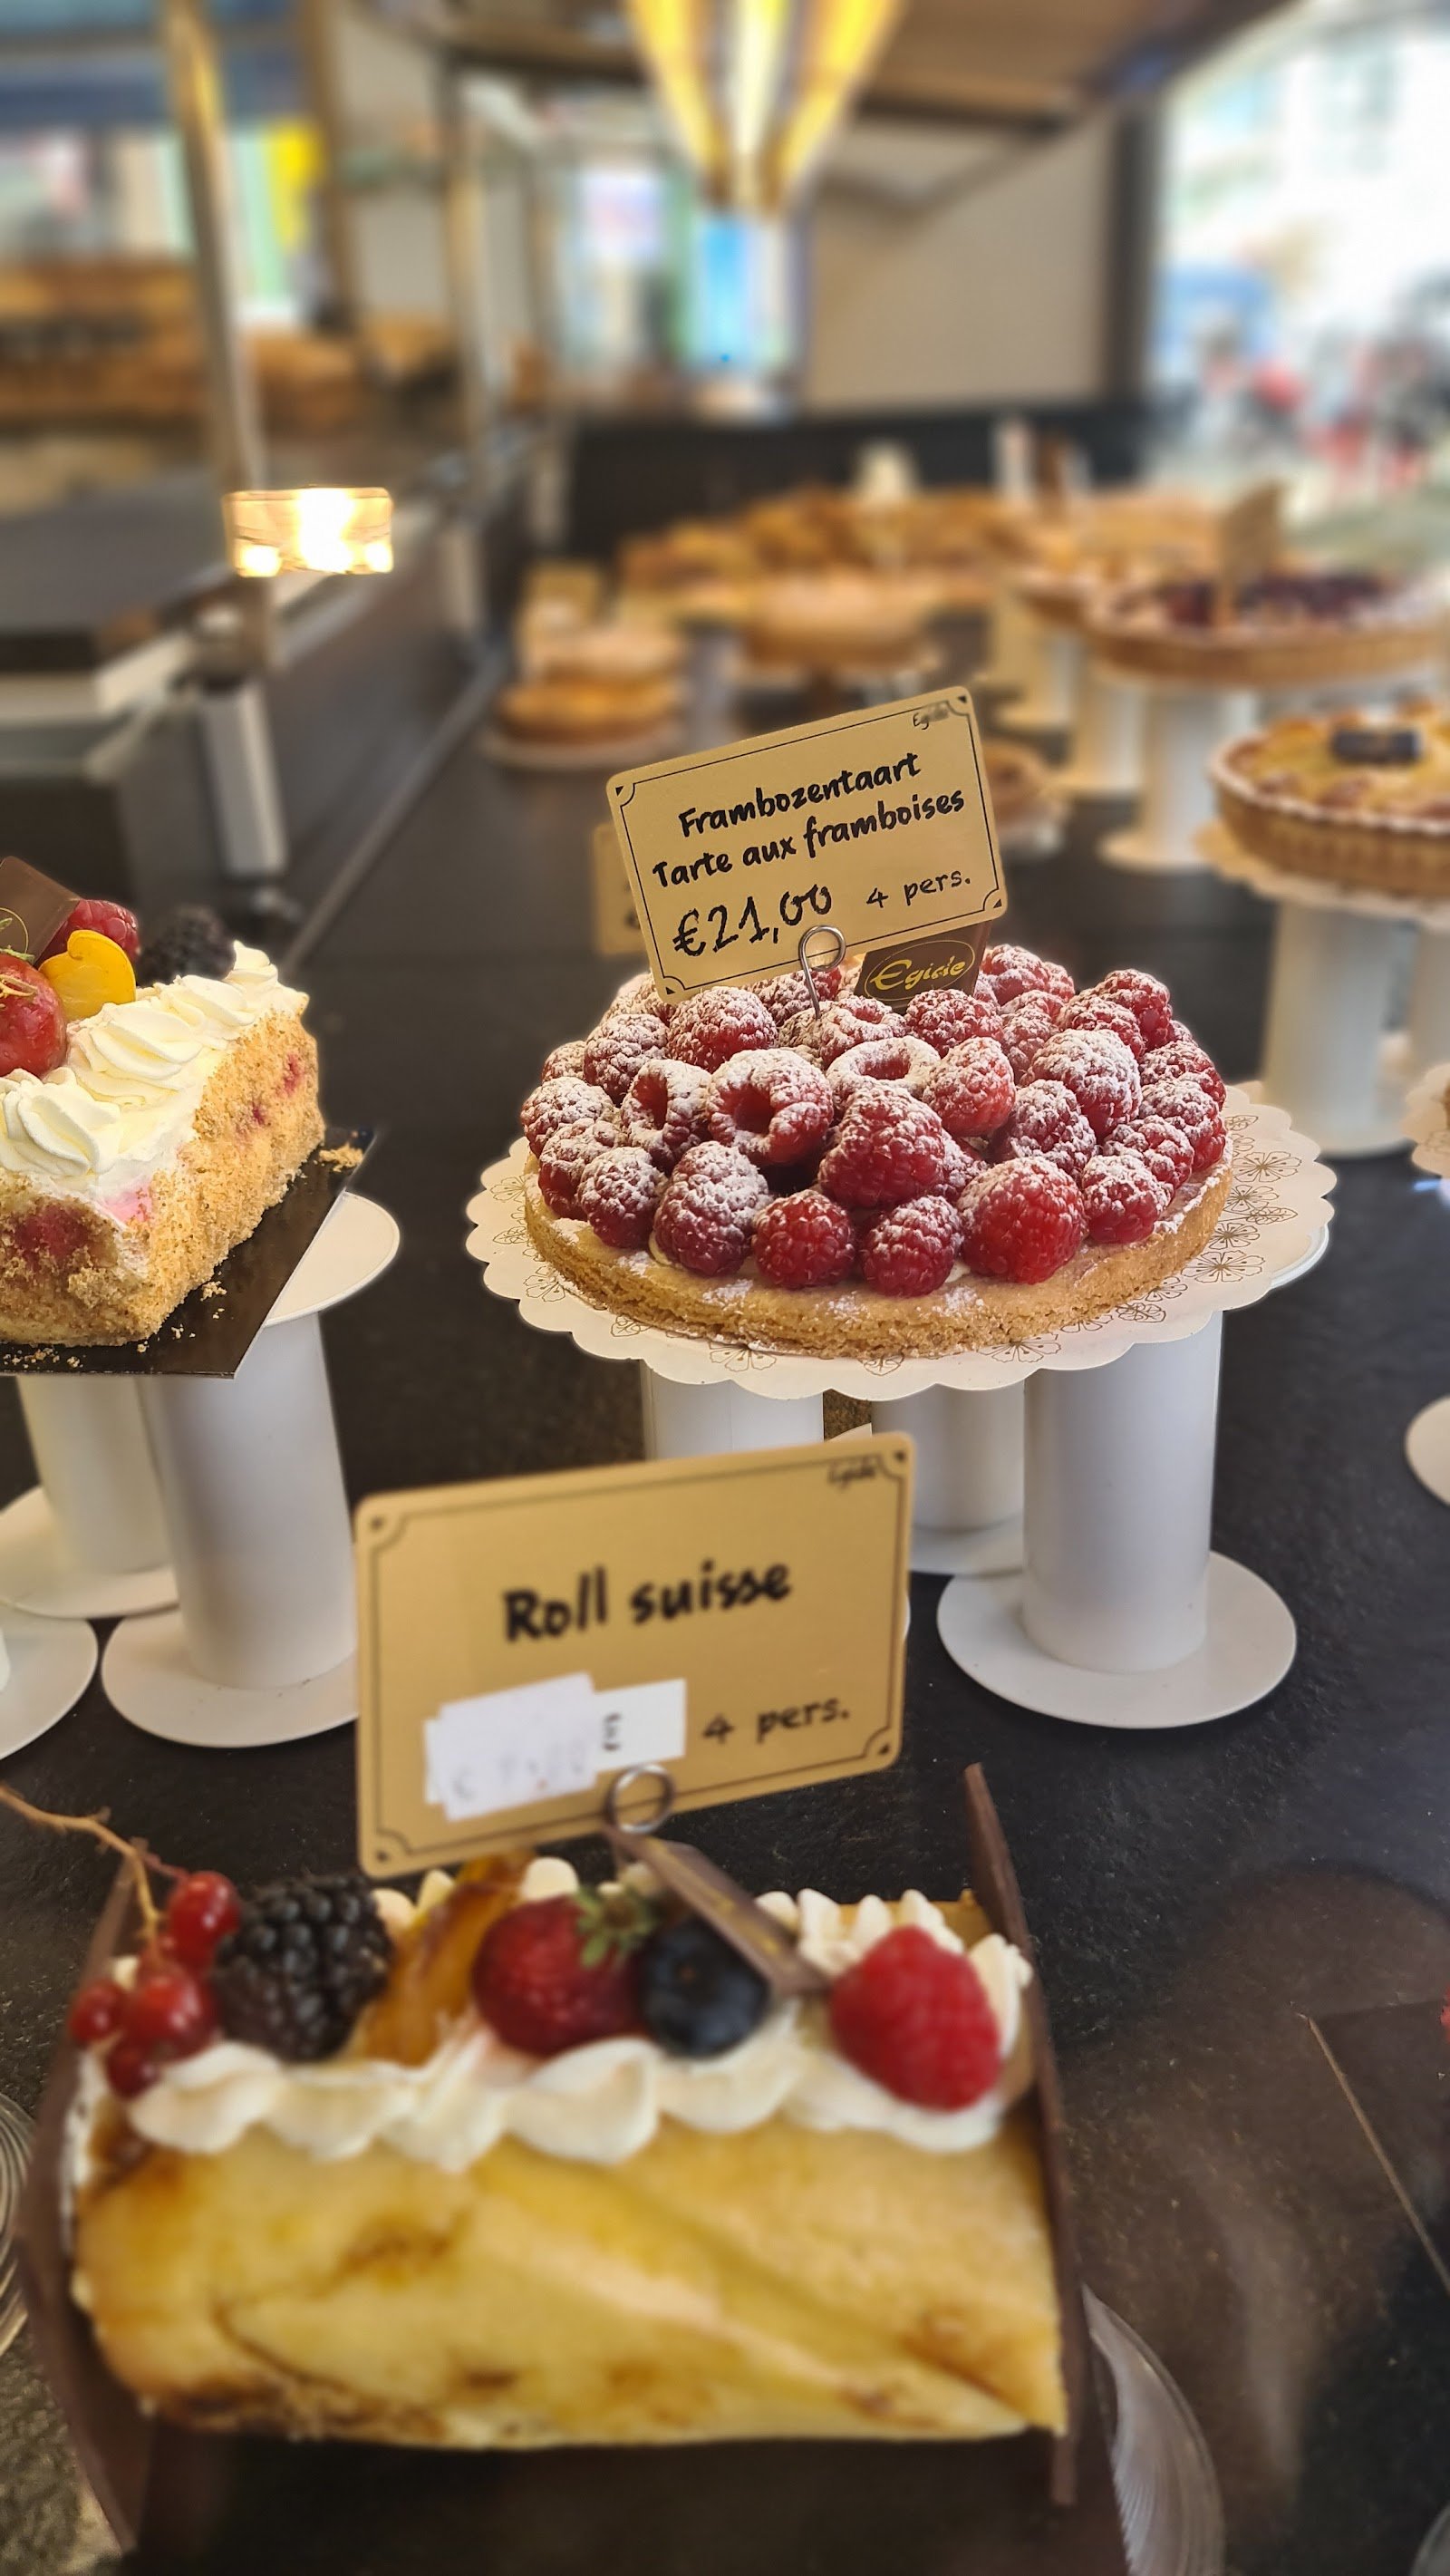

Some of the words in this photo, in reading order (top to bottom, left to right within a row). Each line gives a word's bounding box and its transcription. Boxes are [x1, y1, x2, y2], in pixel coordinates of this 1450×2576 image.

[678, 752, 922, 838] Frambozentaart
[652, 852, 733, 888] Tarte
[742, 836, 798, 867] aux
[802, 789, 965, 859] framboises
[672, 883, 832, 957] €21,00
[865, 886, 889, 909] 4
[904, 870, 971, 906] pers.
[502, 1565, 609, 1643] Roll
[629, 1559, 792, 1626] suisse
[701, 1714, 735, 1744] 4
[756, 1698, 850, 1744] pers.
